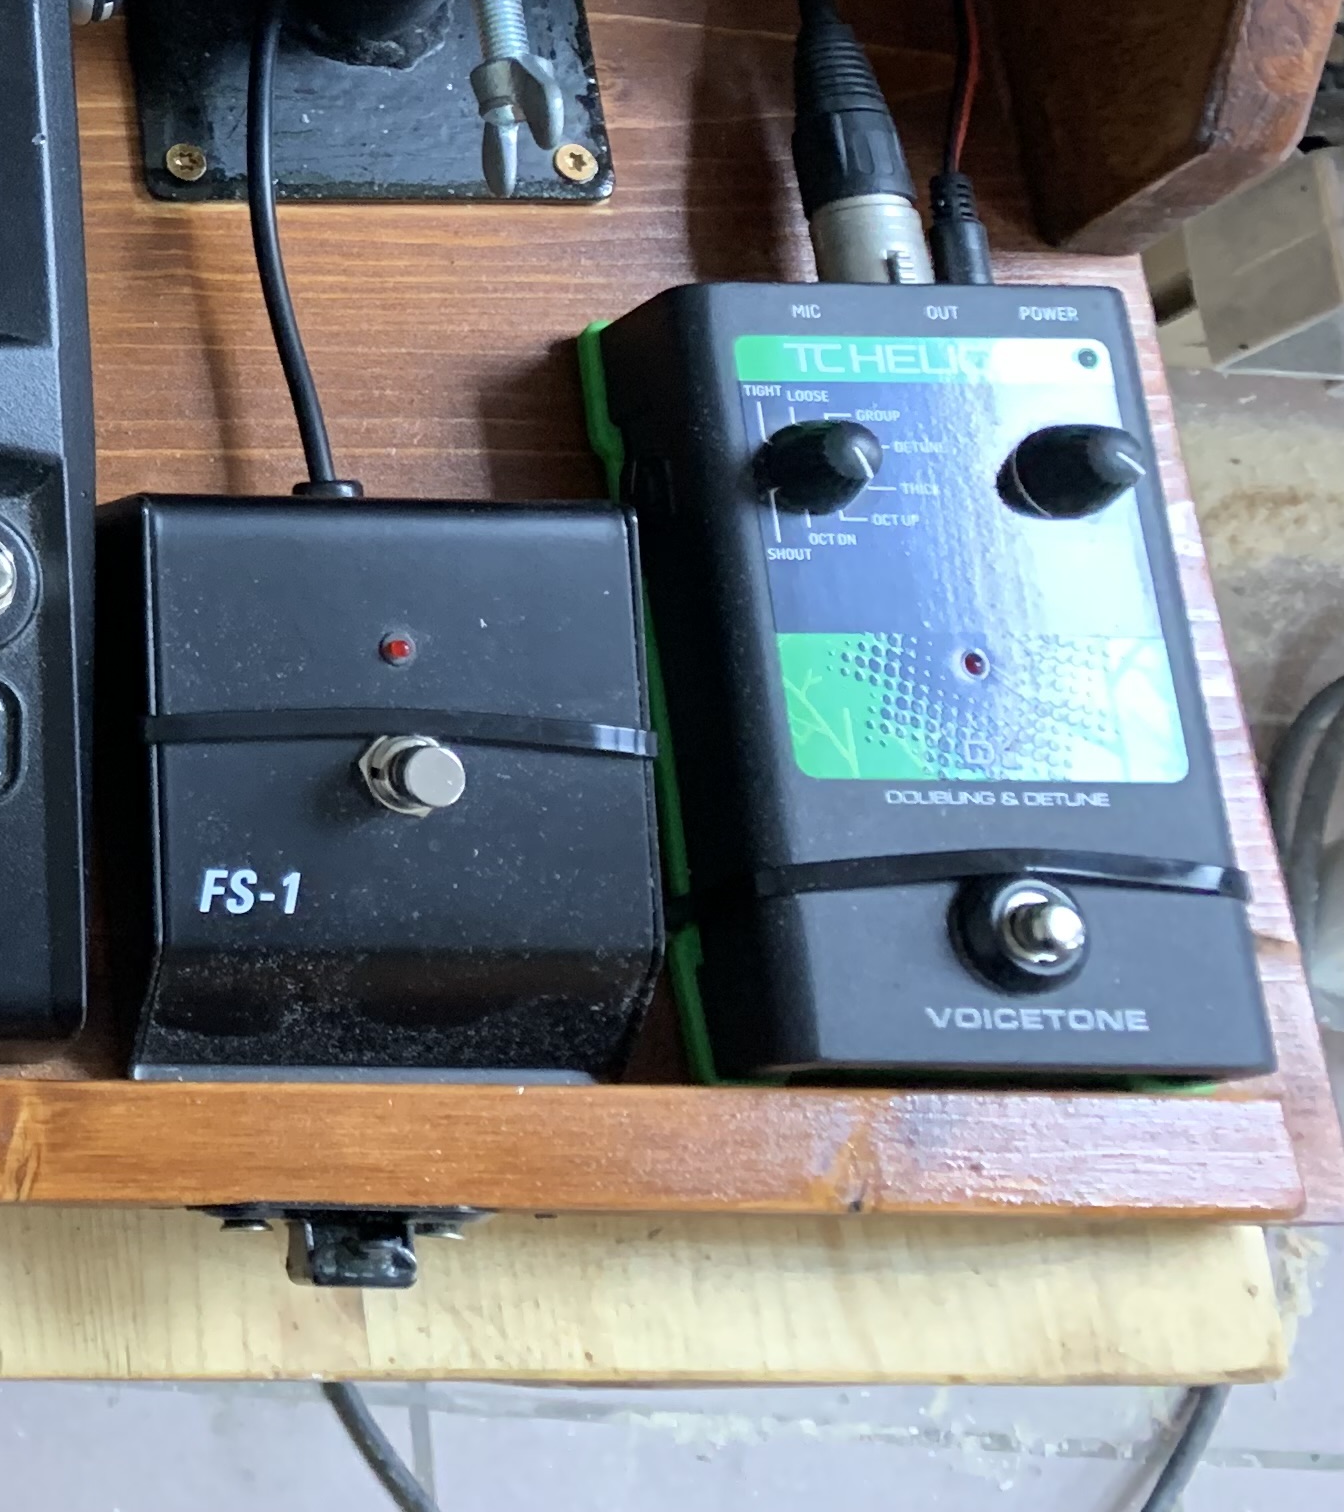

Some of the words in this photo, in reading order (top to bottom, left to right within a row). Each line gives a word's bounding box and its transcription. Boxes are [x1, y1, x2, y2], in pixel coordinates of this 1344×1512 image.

[791, 304, 822, 320] MIC
[925, 304, 960, 321] OUT
[1018, 305, 1079, 323] POWER
[743, 384, 782, 397] TIGHT
[786, 389, 830, 403] LOOSE
[855, 409, 901, 422] GROUP
[871, 514, 899, 527] OCT
[902, 515, 920, 527] UP
[808, 533, 836, 546] OCT
[837, 534, 857, 546] DN
[767, 548, 813, 561] SHOUT
[884, 788, 996, 806] DOUBLING
[1000, 790, 1020, 806] &
[1024, 790, 1111, 808] DETUNE
[197, 868, 302, 915] FS-1
[924, 1005, 1151, 1032] VOICETONE
